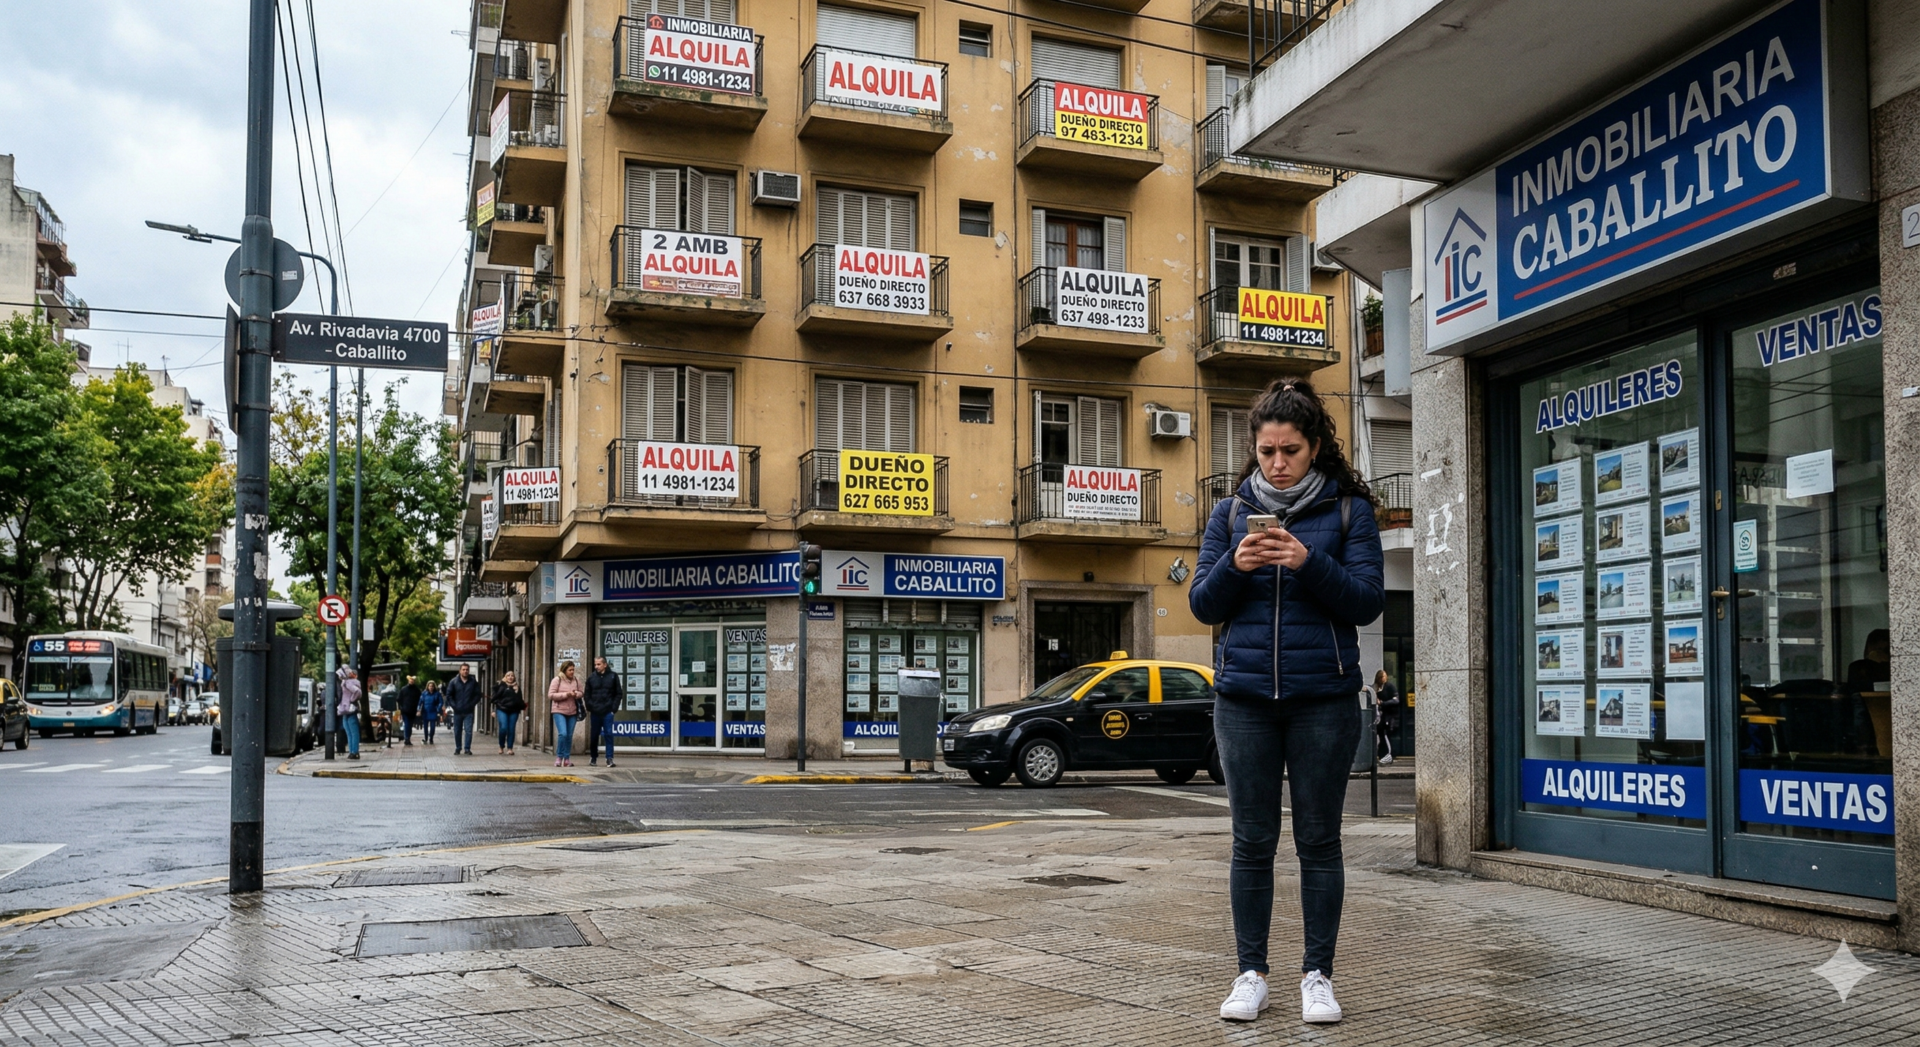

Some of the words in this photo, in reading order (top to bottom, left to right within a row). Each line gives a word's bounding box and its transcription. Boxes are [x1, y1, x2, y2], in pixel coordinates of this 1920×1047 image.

[667, 17, 752, 42] INMOBILIARIA
[649, 35, 750, 69] ALQUILA
[663, 67, 677, 82] 11
[682, 70, 751, 91] 4981-1234
[829, 61, 938, 102] ALQUILA
[1059, 87, 1144, 120] ALQUILA
[1060, 112, 1096, 128] DUEÑO
[1099, 119, 1143, 134] DIRECTO
[1511, 35, 1796, 218] INMOBILIARIA
[1060, 126, 1076, 138] 97
[1081, 128, 1143, 147] 483-1234
[1512, 104, 1798, 281] CABALLITO
[653, 234, 667, 250] 2
[675, 235, 728, 255] AMB
[644, 253, 739, 278] ALQUILA
[839, 249, 926, 279] ALQUILA
[839, 275, 877, 291] DUEÑO
[880, 280, 926, 294] DIRECTO
[1061, 270, 1145, 297] ALQUILA
[839, 290, 863, 305] 637
[867, 292, 890, 308] 668
[893, 294, 925, 311] 3933
[1061, 294, 1098, 308] DUEÑO
[1100, 298, 1145, 312] DIRECTO
[1241, 293, 1324, 325] ALQUILA
[1061, 309, 1084, 323] 637
[1087, 311, 1145, 329] 498-1233
[289, 319, 315, 337] Av.
[319, 321, 400, 341] Rivadavia
[403, 326, 442, 344] 4700
[1242, 326, 1257, 339] 11
[1261, 327, 1324, 345] 4981-1234
[1755, 294, 1883, 368] VENTAS
[1535, 358, 1683, 435] ALQUILERES
[642, 446, 736, 472] ALQUILA
[849, 455, 925, 474] DUEÑO
[505, 470, 558, 486] ALQUILA
[642, 474, 658, 489] 11
[663, 475, 736, 492] 4981-1234
[845, 474, 930, 492] DIRECTO
[1067, 469, 1138, 492] ALQUILA
[505, 489, 515, 500] 11
[517, 487, 559, 500] 4981-1234
[844, 493, 868, 509] 627
[874, 493, 900, 510] 665
[904, 495, 930, 511] 953
[1067, 491, 1098, 504] DUEÑO
[1100, 494, 1138, 505] DIRECTO
[894, 558, 998, 575] INMOBILIARIA
[609, 568, 712, 590] INMOBILIARIA
[894, 574, 997, 594] CABALLITO
[44, 640, 65, 652] 55
[604, 630, 669, 645] ALQUILERES
[725, 723, 766, 736] VENTAS
[1542, 766, 1687, 808] ALQUILERES
[1760, 778, 1888, 823] VENTAS
